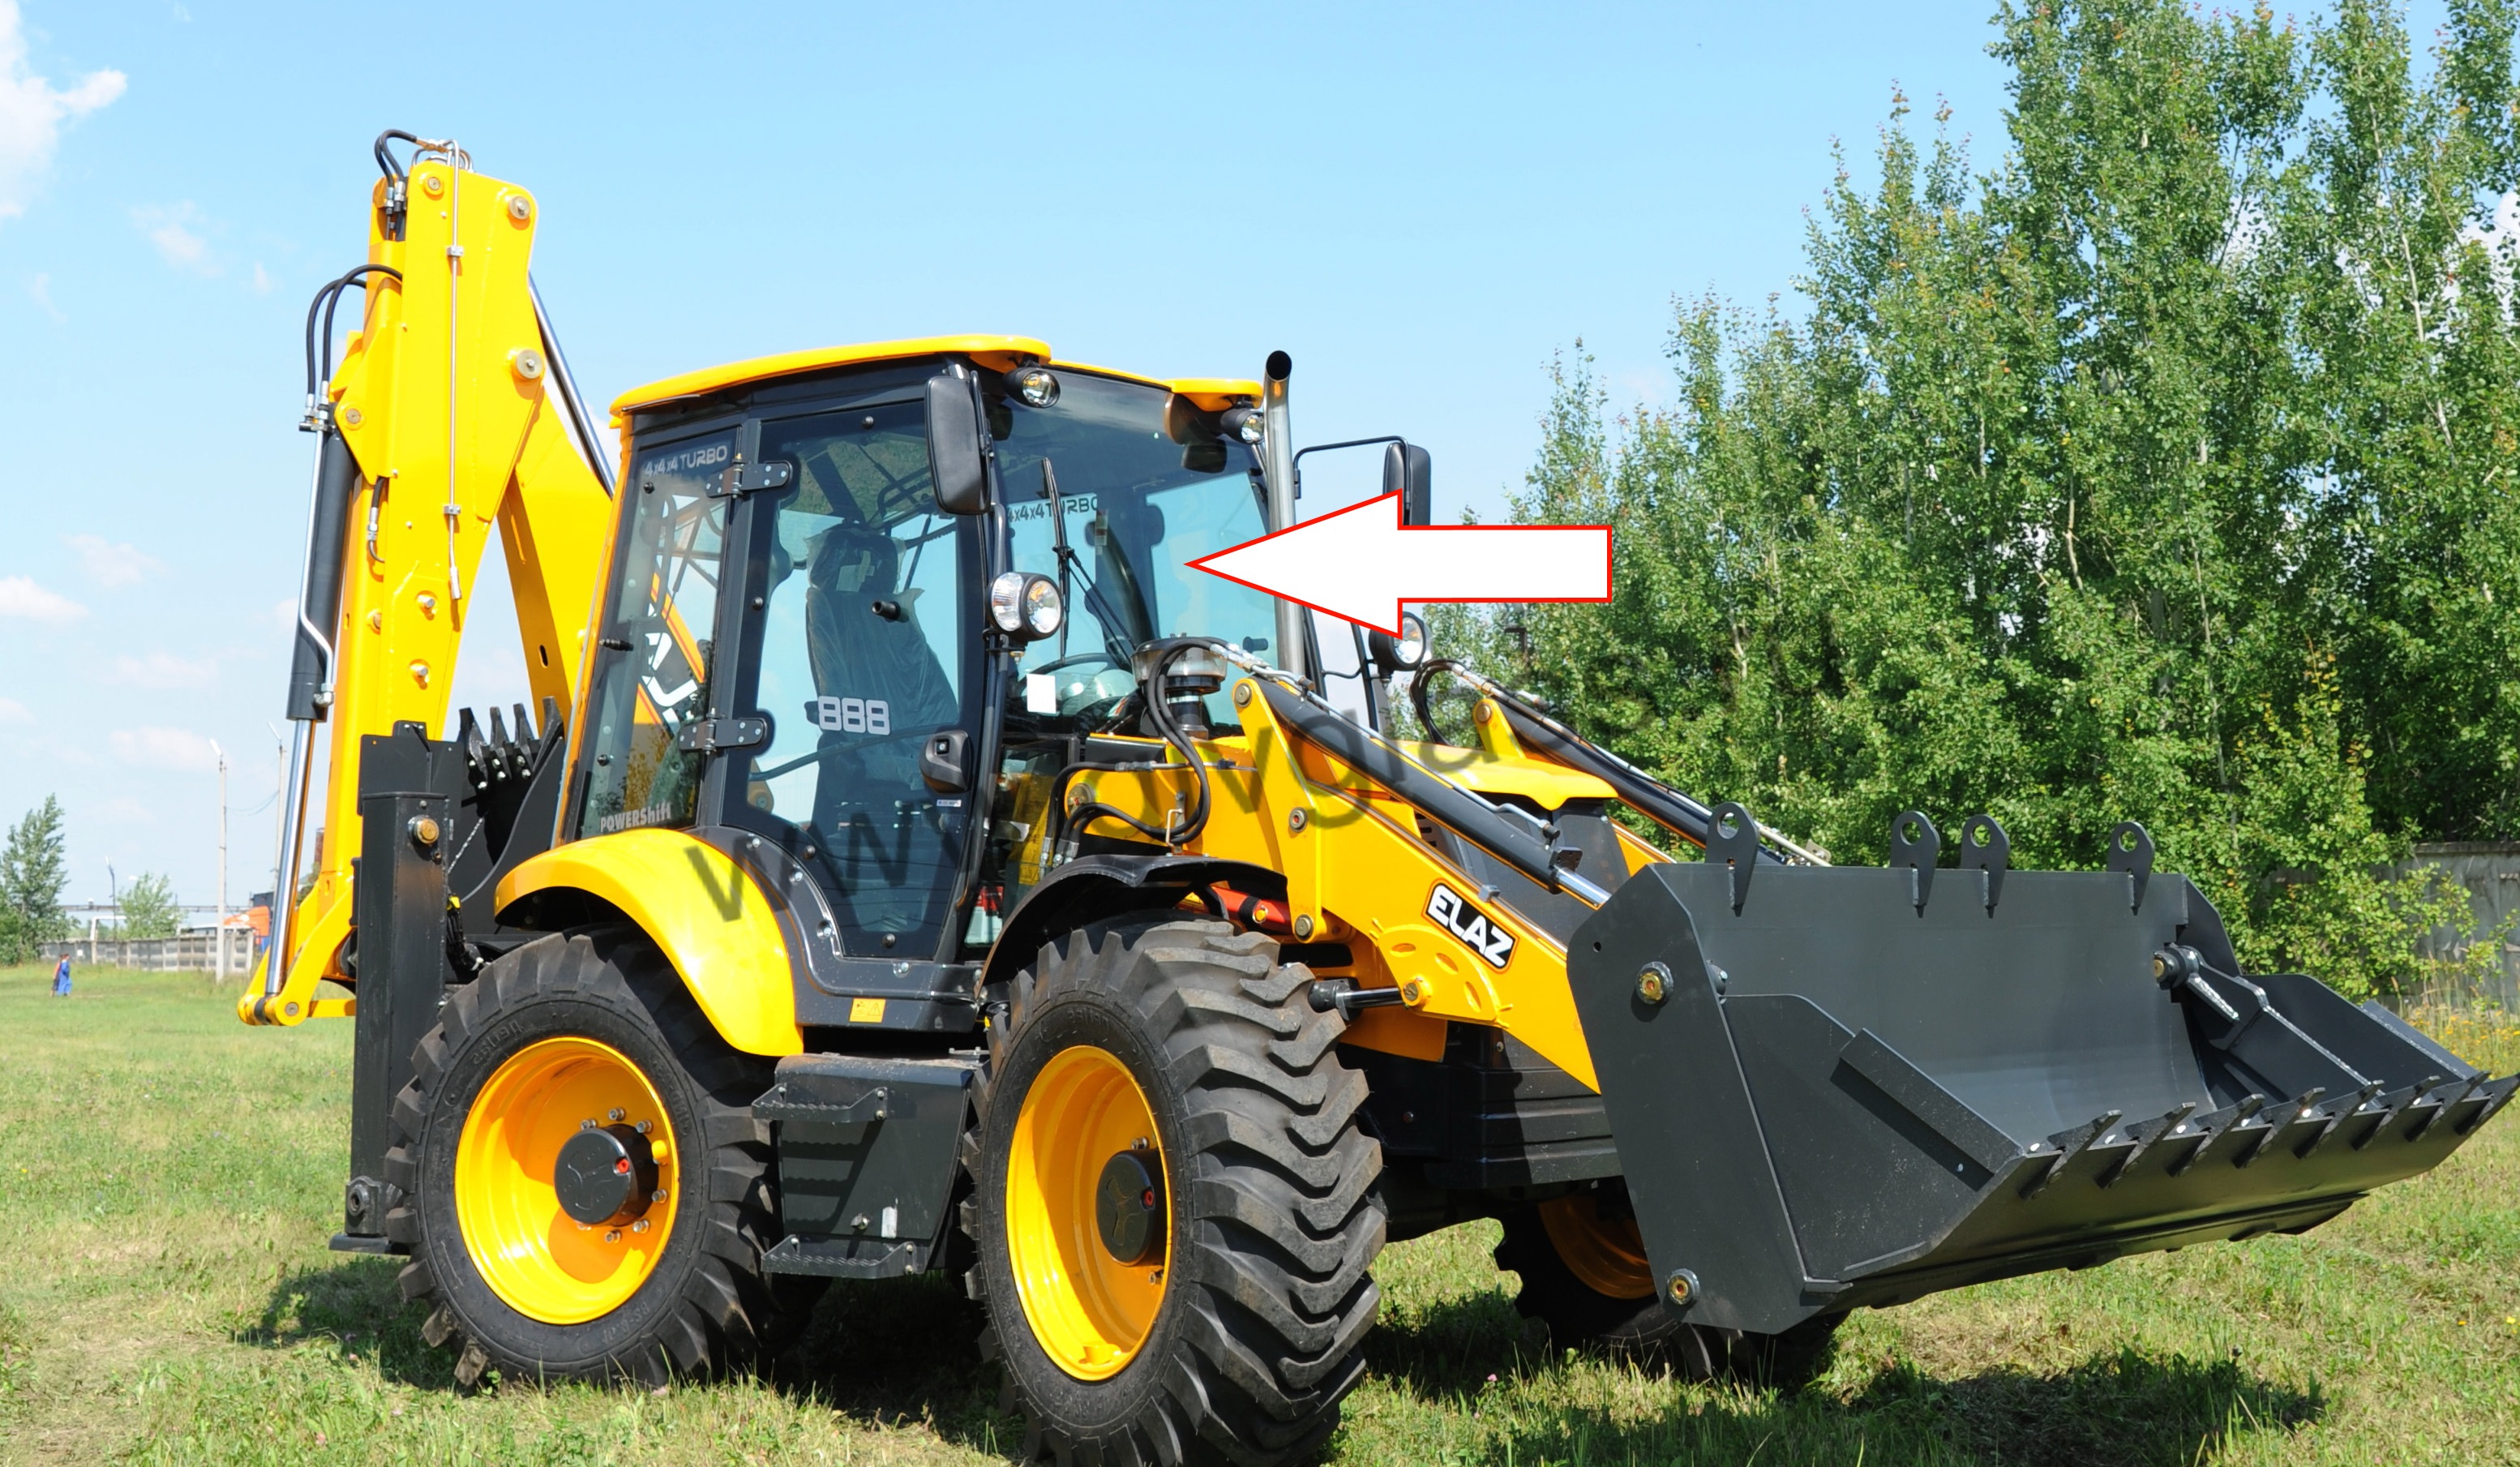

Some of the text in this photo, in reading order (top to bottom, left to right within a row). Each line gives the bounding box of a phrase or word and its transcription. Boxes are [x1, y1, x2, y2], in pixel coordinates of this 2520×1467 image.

[679, 444, 728, 470] TURBO
[818, 695, 890, 736] 888
[1427, 884, 1515, 967] ELAZ
